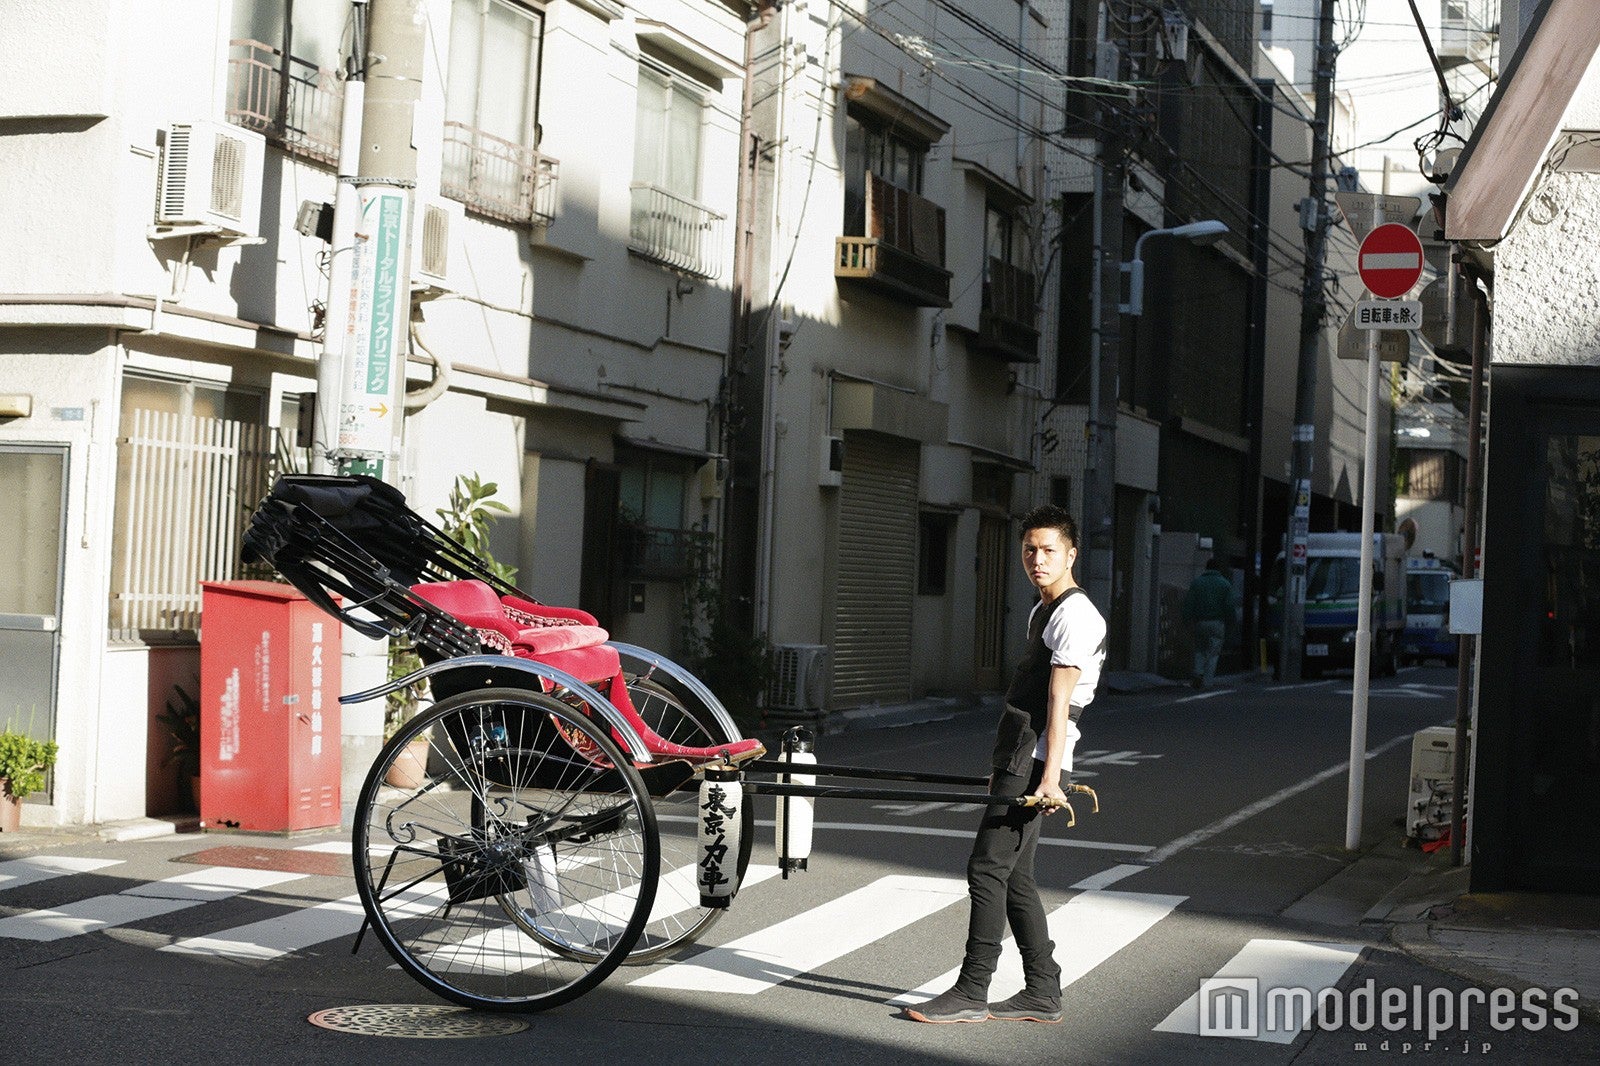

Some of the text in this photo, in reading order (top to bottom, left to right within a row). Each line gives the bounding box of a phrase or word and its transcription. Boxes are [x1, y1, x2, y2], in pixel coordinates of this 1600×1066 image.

[1360, 307, 1417, 323] 自転車を除く
[699, 784, 737, 894] 東京力車
